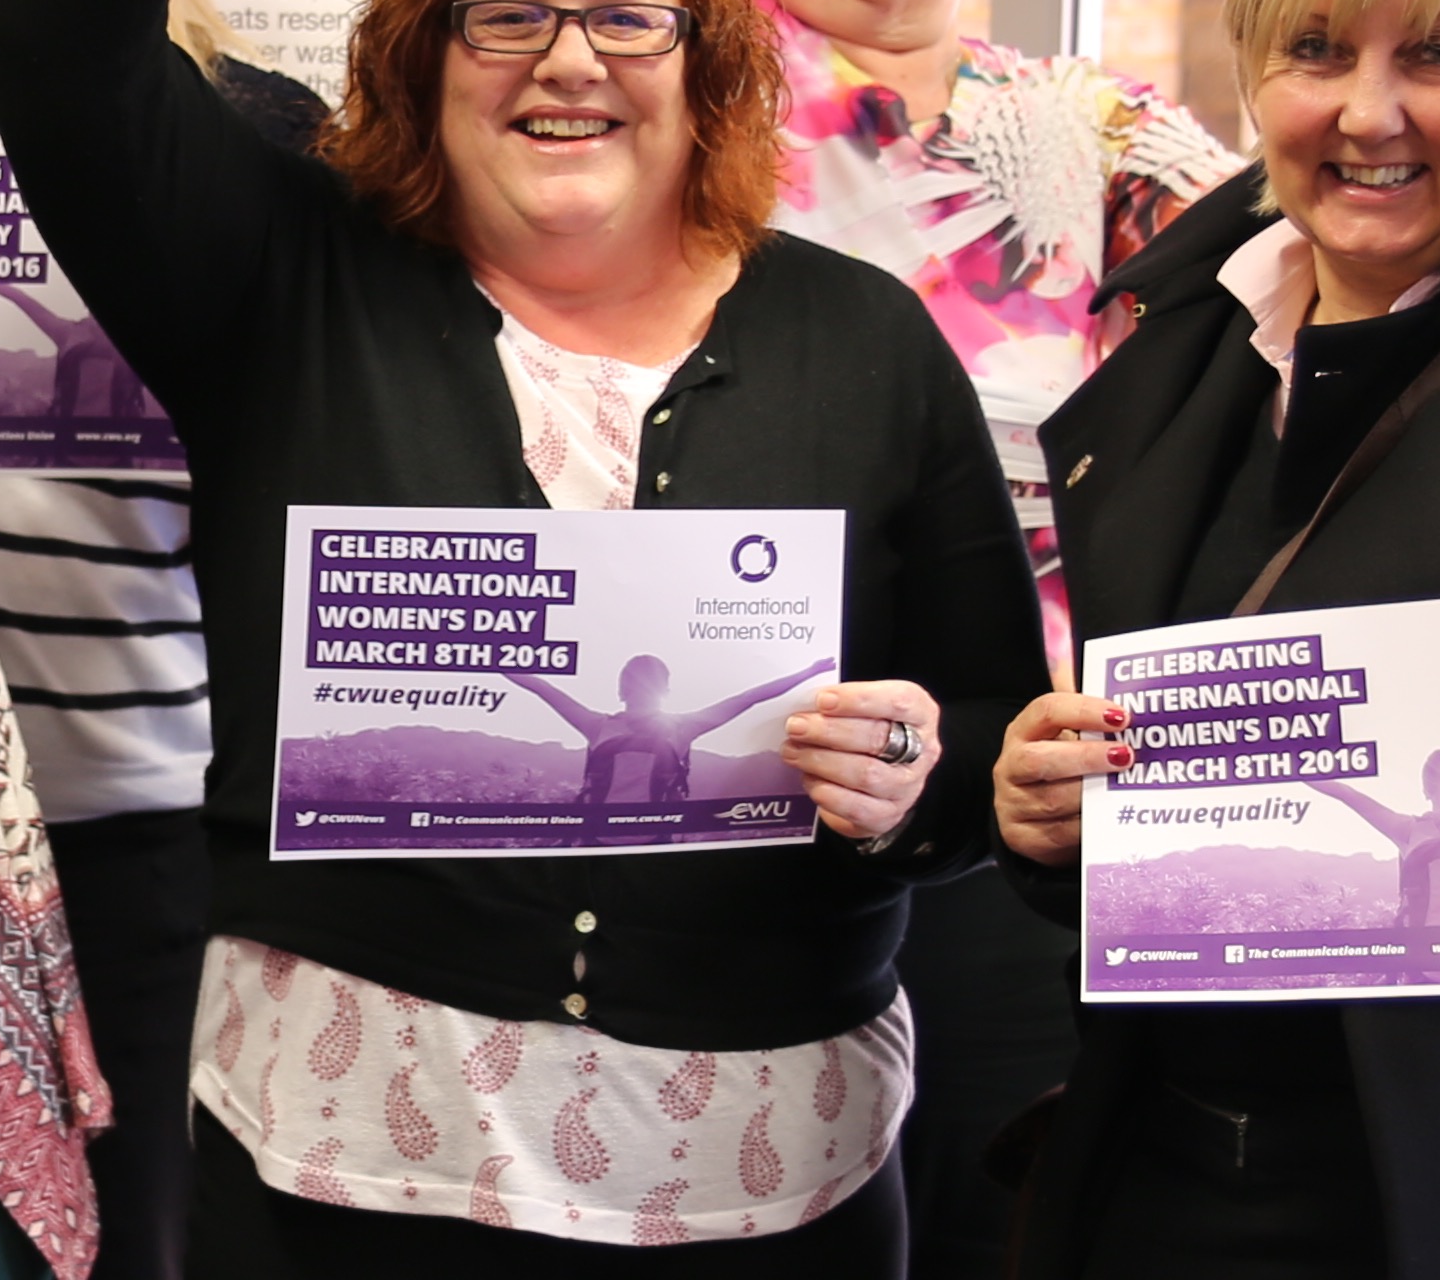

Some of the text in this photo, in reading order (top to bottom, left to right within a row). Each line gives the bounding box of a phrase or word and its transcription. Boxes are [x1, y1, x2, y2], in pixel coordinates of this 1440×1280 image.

[321, 535, 524, 561] CELEBRATING
[320, 571, 567, 598] INTERNATIONAL
[695, 597, 809, 616] International
[473, 608, 536, 633] DAY
[779, 622, 815, 644] Day
[316, 640, 569, 669] MARCH 8TH 2016
[1114, 641, 1312, 682] CELEBRATING
[314, 683, 507, 713] #cwuequality
[1114, 677, 1360, 713] INTERNATIONAL
[1267, 714, 1331, 738] DAY
[1118, 748, 1369, 786] MARCH 8TH 2016
[433, 814, 583, 825] The Communications Union
[730, 801, 790, 820] CWU
[1118, 798, 1311, 828] #cwuequality
[1130, 949, 1198, 962] @CWUNews
[1248, 943, 1405, 959] The Communications Union
